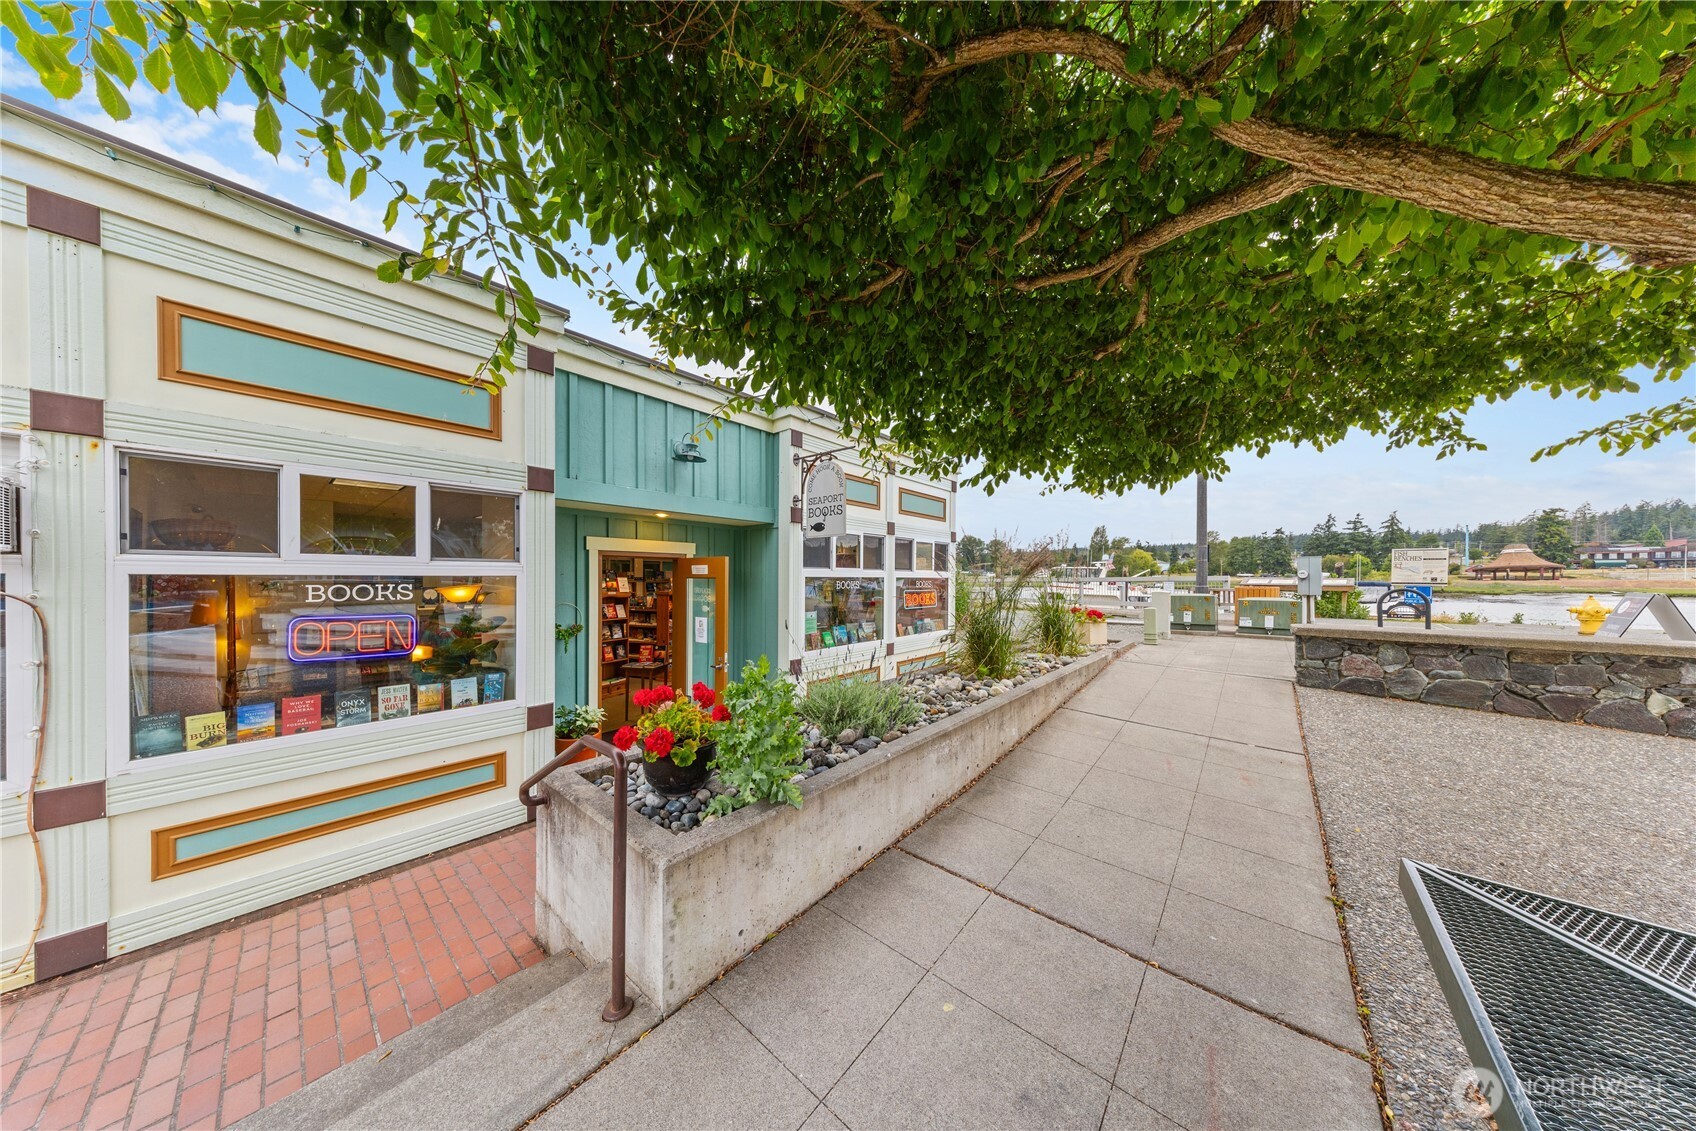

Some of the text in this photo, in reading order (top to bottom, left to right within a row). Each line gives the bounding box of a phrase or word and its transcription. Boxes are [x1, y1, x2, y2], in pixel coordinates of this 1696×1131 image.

[808, 474, 817, 493] COME
[815, 463, 831, 475] HOOK
[834, 469, 844, 488] BOOK
[808, 493, 844, 506] SEAPORT
[808, 504, 844, 519] BOOKS
[836, 580, 860, 590] BOOKS
[915, 580, 932, 588] BOOKS
[305, 583, 414, 603] BOOKS
[905, 591, 936, 607] BOOKS
[293, 619, 412, 656] OPEN
[381, 686, 391, 695] JESS
[341, 698, 365, 708] ONYX
[381, 694, 408, 704] SO FAR
[340, 707, 367, 716] STORM
[384, 702, 405, 712] GONE
[203, 722, 226, 732] BIG
[190, 728, 227, 741] BURN
